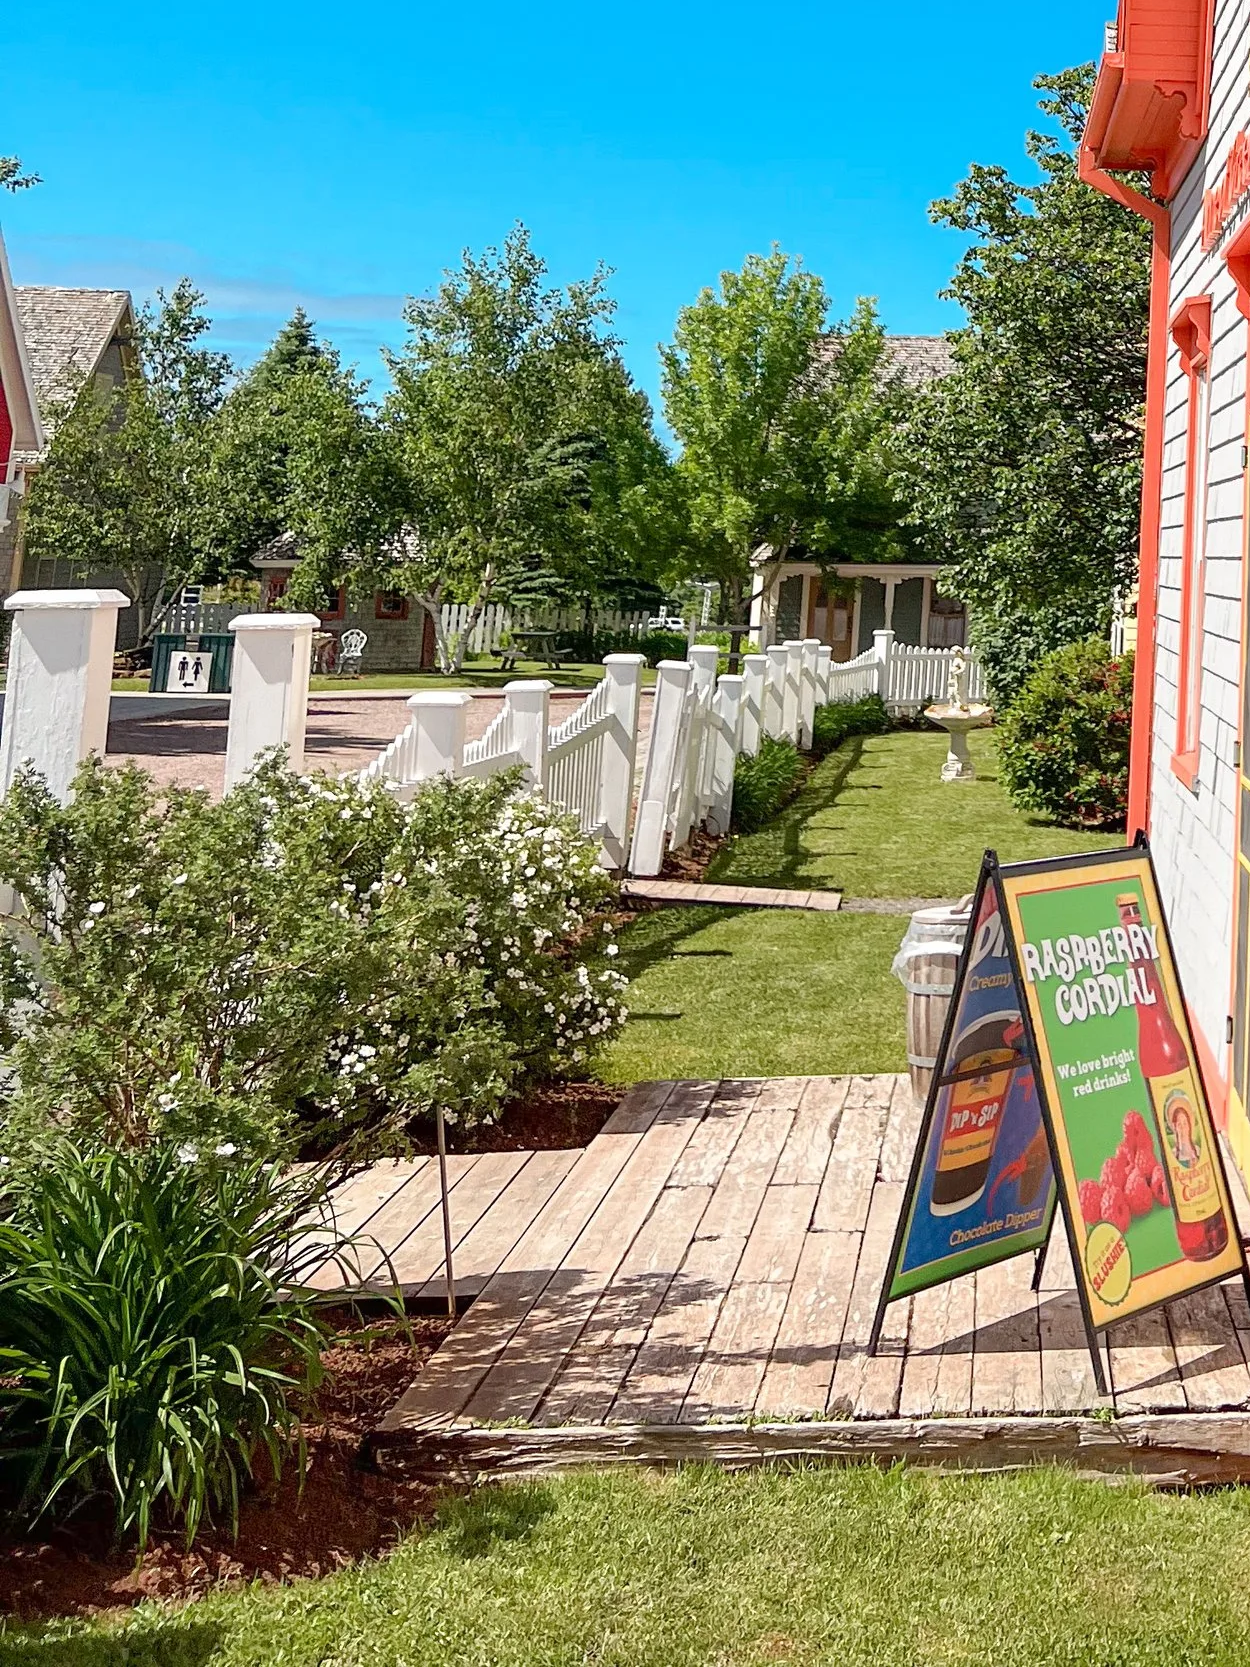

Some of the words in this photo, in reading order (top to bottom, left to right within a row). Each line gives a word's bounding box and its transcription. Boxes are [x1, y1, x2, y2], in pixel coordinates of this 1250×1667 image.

[1020, 924, 1160, 982] RASPBERRY
[969, 972, 1013, 992] Creamy
[1055, 968, 1157, 1026] CORDIAL
[1057, 1064, 1077, 1080] We
[1077, 1057, 1101, 1076] love
[1101, 1049, 1135, 1071] bright
[1072, 1080, 1092, 1097] red
[1093, 1069, 1131, 1093] drinks!
[950, 1110, 969, 1132] DIP
[978, 1102, 999, 1127] SIP
[950, 1219, 1003, 1246] Chocolate
[1005, 1207, 1043, 1229] Dipper
[1092, 1237, 1126, 1292] SLUSHIE
